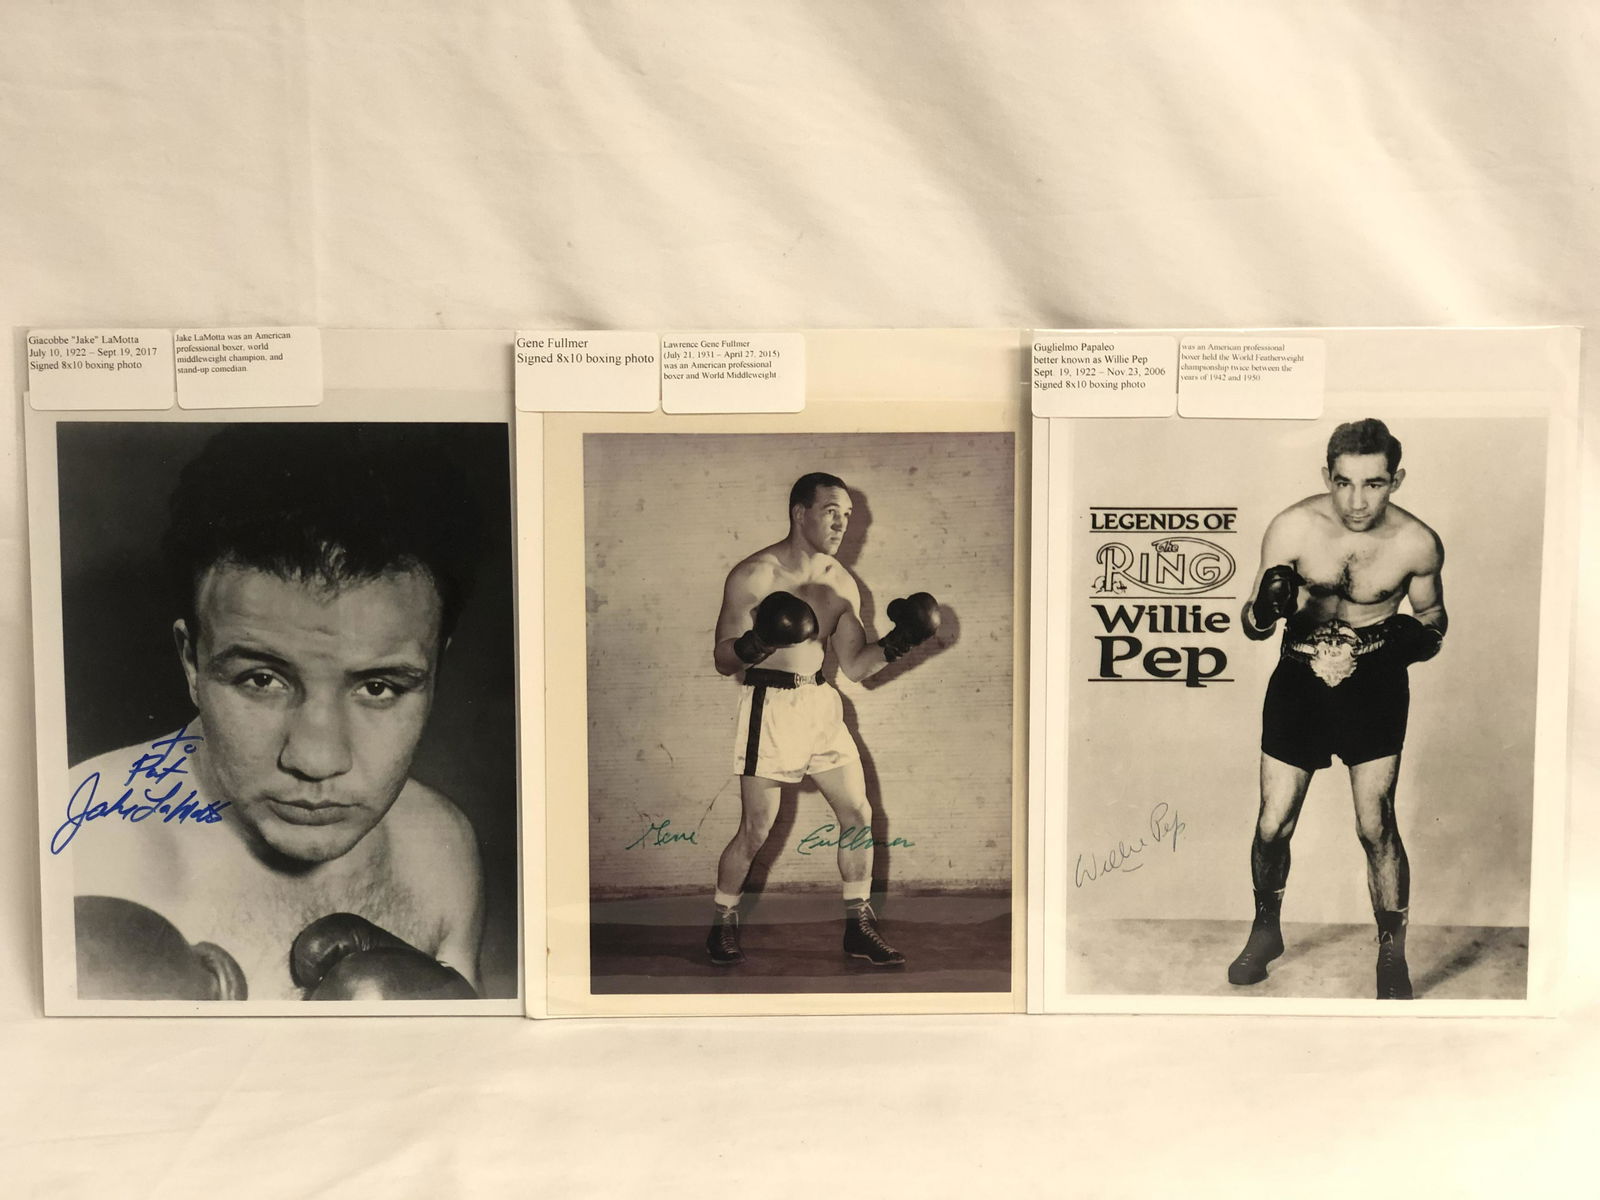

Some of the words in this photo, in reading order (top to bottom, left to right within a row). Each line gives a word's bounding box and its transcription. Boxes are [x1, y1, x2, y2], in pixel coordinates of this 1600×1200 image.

[28, 336, 68, 344] Giacobbe
[71, 336, 99, 344] "Jake"
[102, 336, 139, 344] LaMotta
[176, 334, 192, 342] Jake
[255, 332, 291, 340] American
[517, 338, 544, 348] Gene
[548, 338, 588, 348] Fullmer
[721, 340, 750, 348] Fullmer
[1034, 343, 1078, 353] Guglielmo
[1081, 342, 1114, 353] Papaleo
[1243, 344, 1285, 352] professional
[30, 348, 46, 358] July
[66, 348, 86, 356] 1922
[136, 348, 157, 356] 2017
[176, 344, 220, 354] professional
[177, 355, 226, 363] middleweight
[517, 353, 553, 365] Signed
[557, 353, 582, 363] 8x10
[586, 353, 622, 365] boxing
[625, 353, 654, 365] photo
[663, 352, 680, 360] (July
[724, 351, 742, 359] April
[759, 350, 780, 358] 2015)
[1034, 356, 1058, 364] better
[1061, 356, 1090, 364] known
[1105, 355, 1129, 363] Willie
[1132, 355, 1148, 365] Pep
[1255, 354, 1304, 363] Featherweight
[30, 362, 58, 371] Signed
[62, 361, 82, 369] 8x10
[86, 361, 114, 370] boxing
[117, 361, 142, 370] photo
[177, 366, 209, 374] stand-up
[728, 361, 772, 370] professional
[1181, 364, 1229, 372] championship
[1251, 364, 1280, 372] between
[664, 372, 684, 380] boxer
[726, 371, 776, 380] Middleweight
[1076, 368, 1096, 376] 1922
[1107, 368, 1126, 376] Nov
[1144, 368, 1166, 376] 2006
[1034, 380, 1063, 390] Signed
[1066, 380, 1087, 388] 8x10
[1090, 380, 1118, 390] boxing
[1121, 380, 1146, 390] photo
[1090, 513, 1199, 530] LEGENDS
[1203, 513, 1237, 530] OF
[1096, 542, 1236, 595] RING
[1091, 605, 1231, 633] Willie
[1094, 636, 1227, 688] Pep
[1150, 802, 1185, 852] Pep
